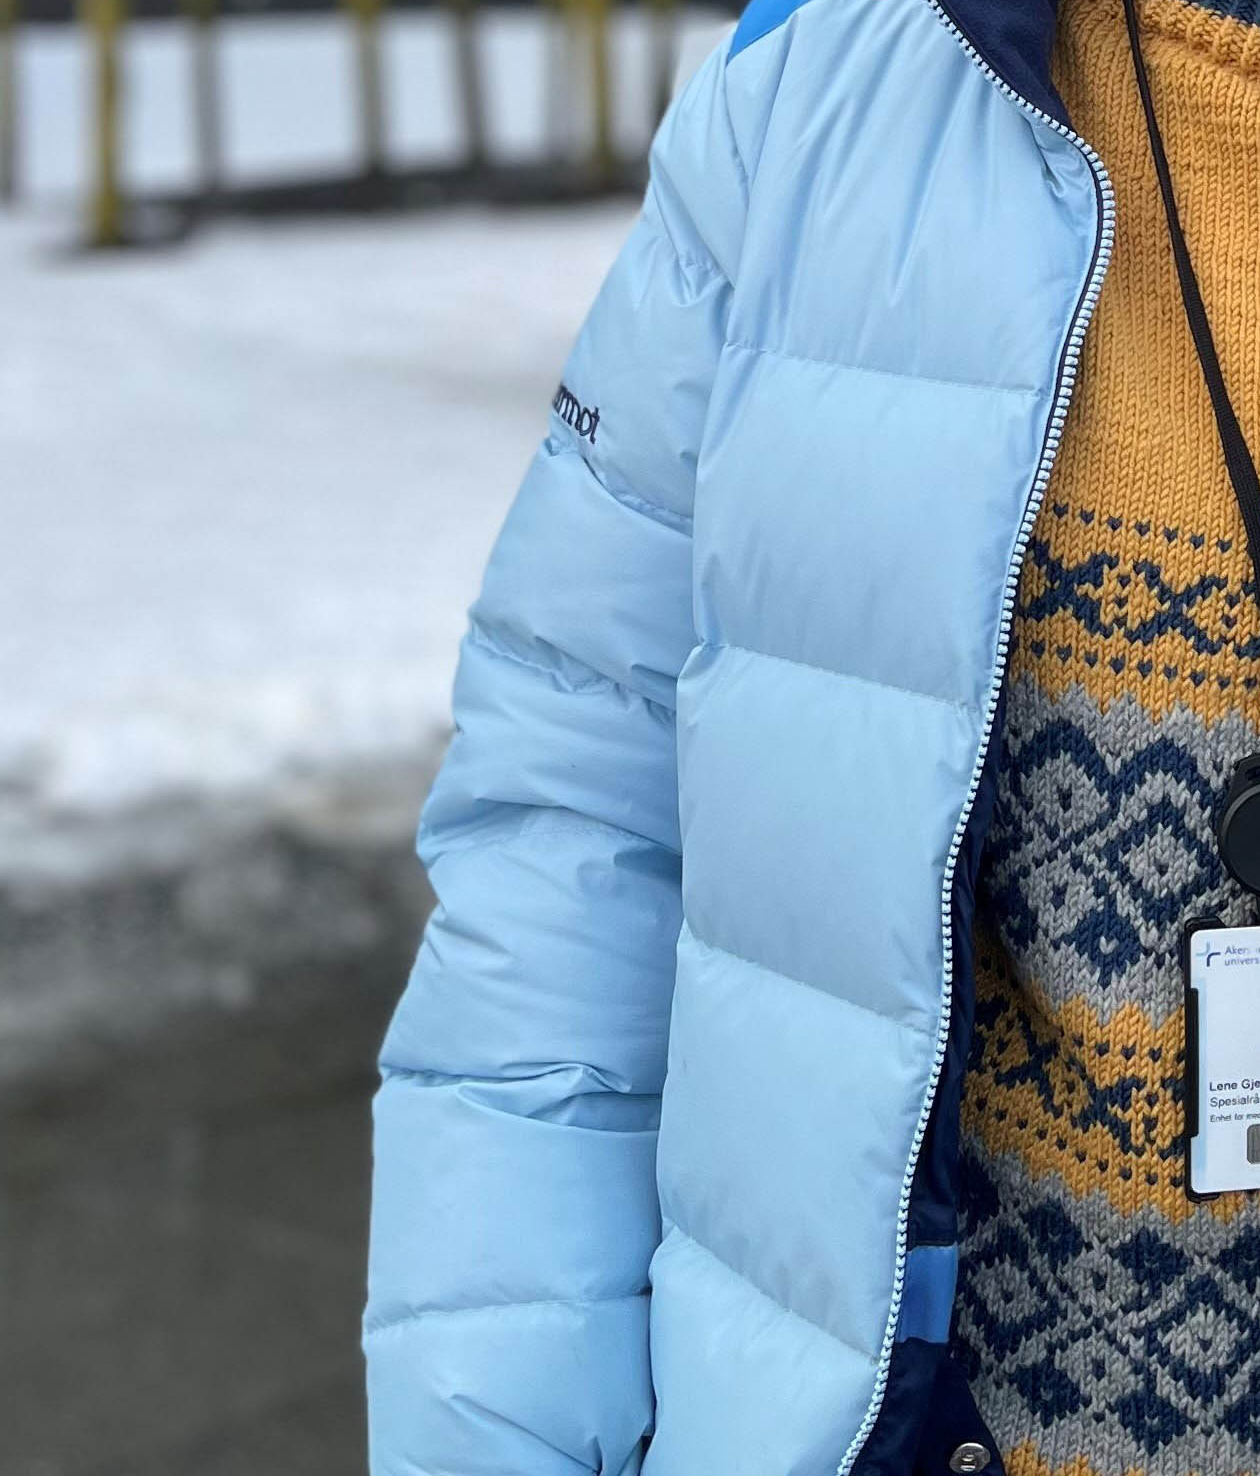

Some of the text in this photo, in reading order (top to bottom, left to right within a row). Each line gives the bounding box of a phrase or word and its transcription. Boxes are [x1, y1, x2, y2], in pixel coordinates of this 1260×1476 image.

[1209, 1081, 1238, 1092] Lene
[1210, 1113, 1231, 1123] Enhet
[1234, 1112, 1243, 1121] for
